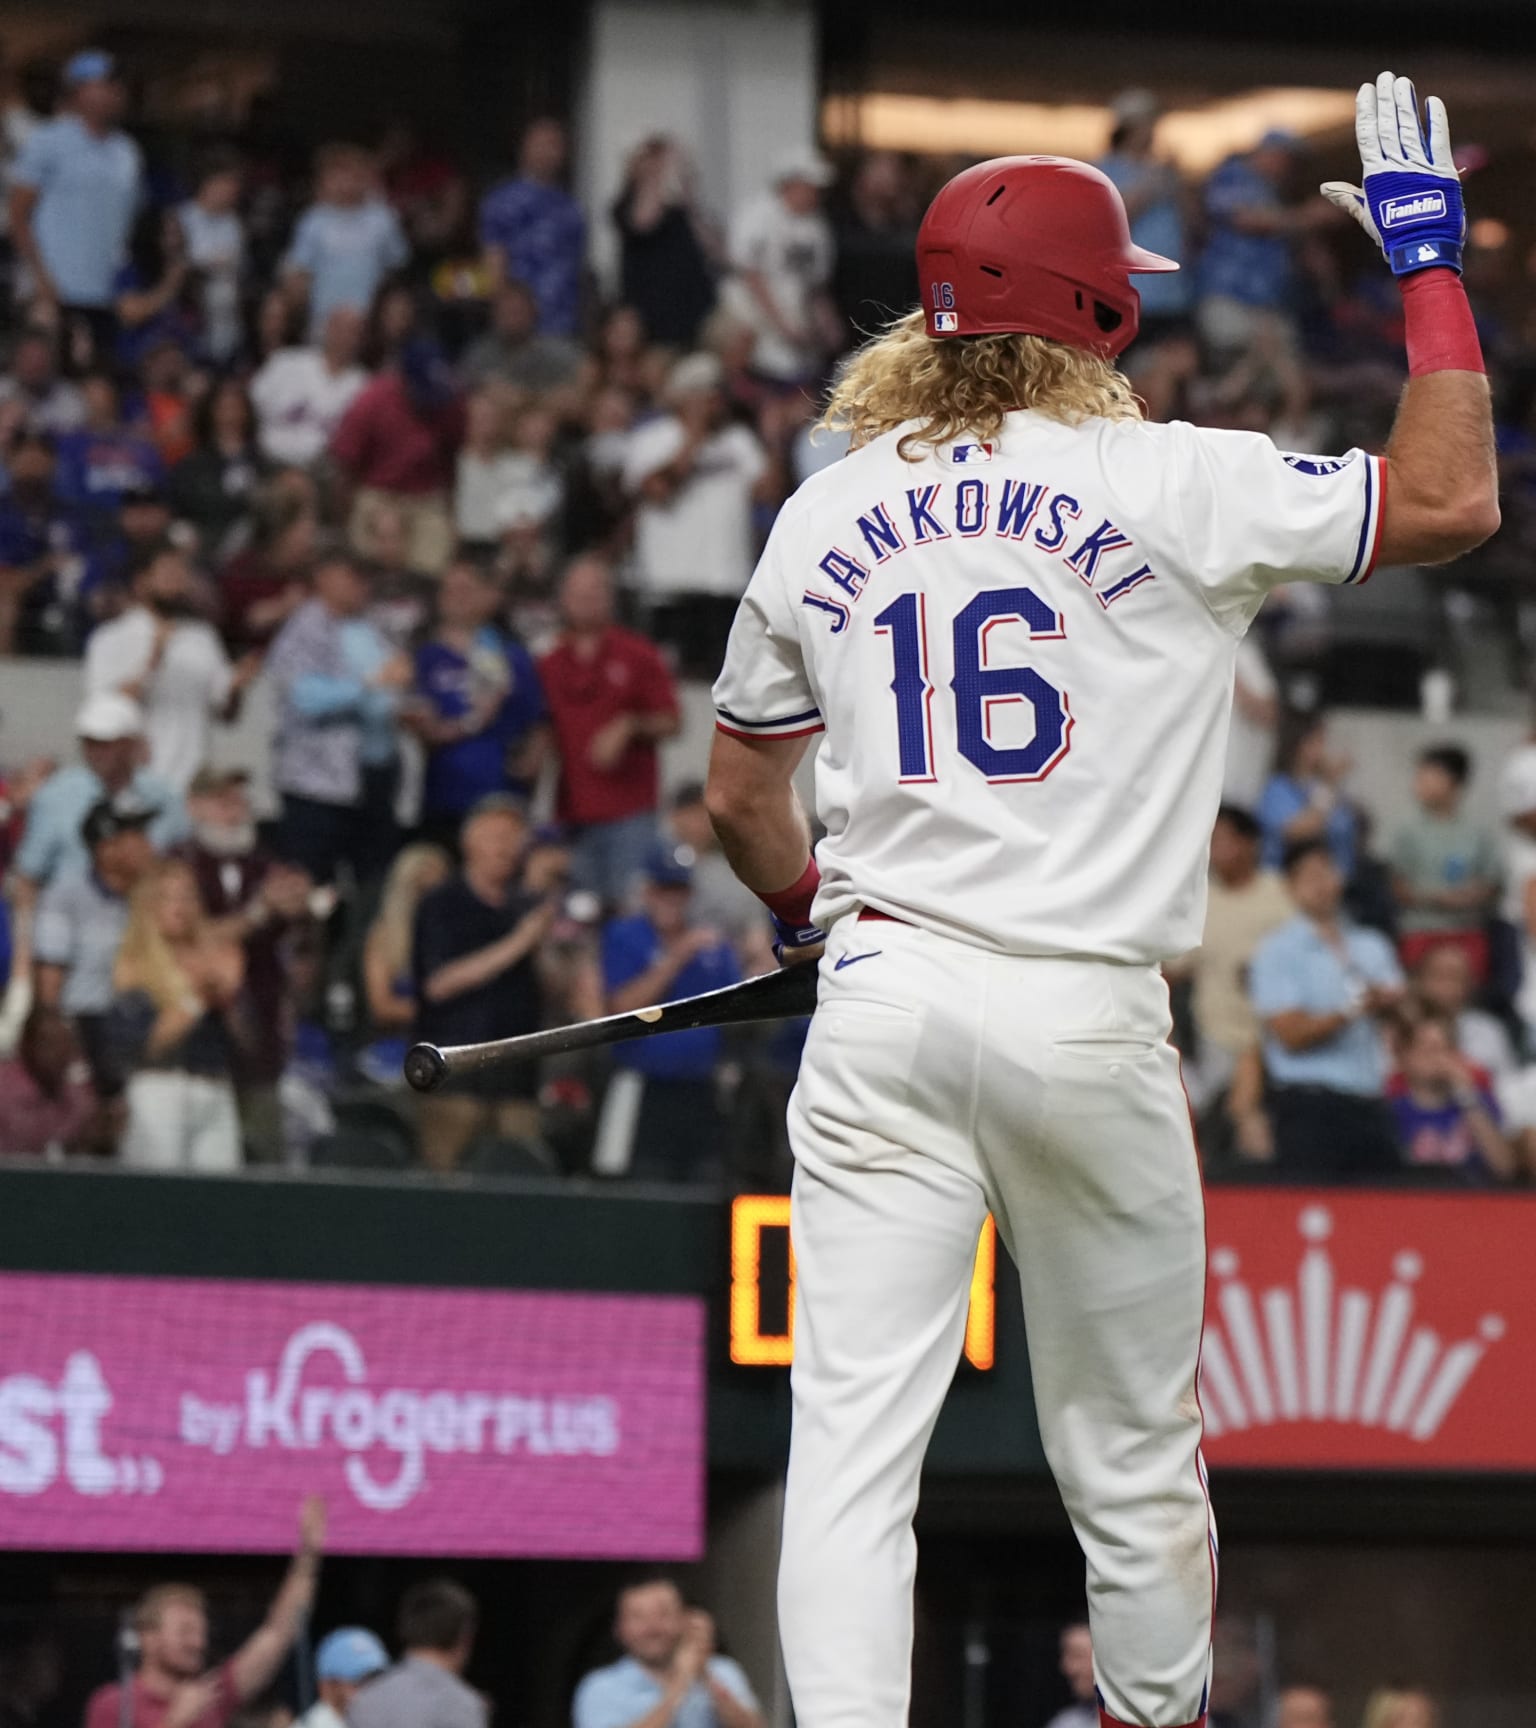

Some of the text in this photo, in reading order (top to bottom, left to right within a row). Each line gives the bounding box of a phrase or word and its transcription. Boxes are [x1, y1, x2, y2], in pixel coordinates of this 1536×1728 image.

[931, 282, 955, 309] 16
[802, 479, 1156, 634] JANKOWSKI
[873, 587, 1076, 785] 16
[179, 1391, 239, 1455] by
